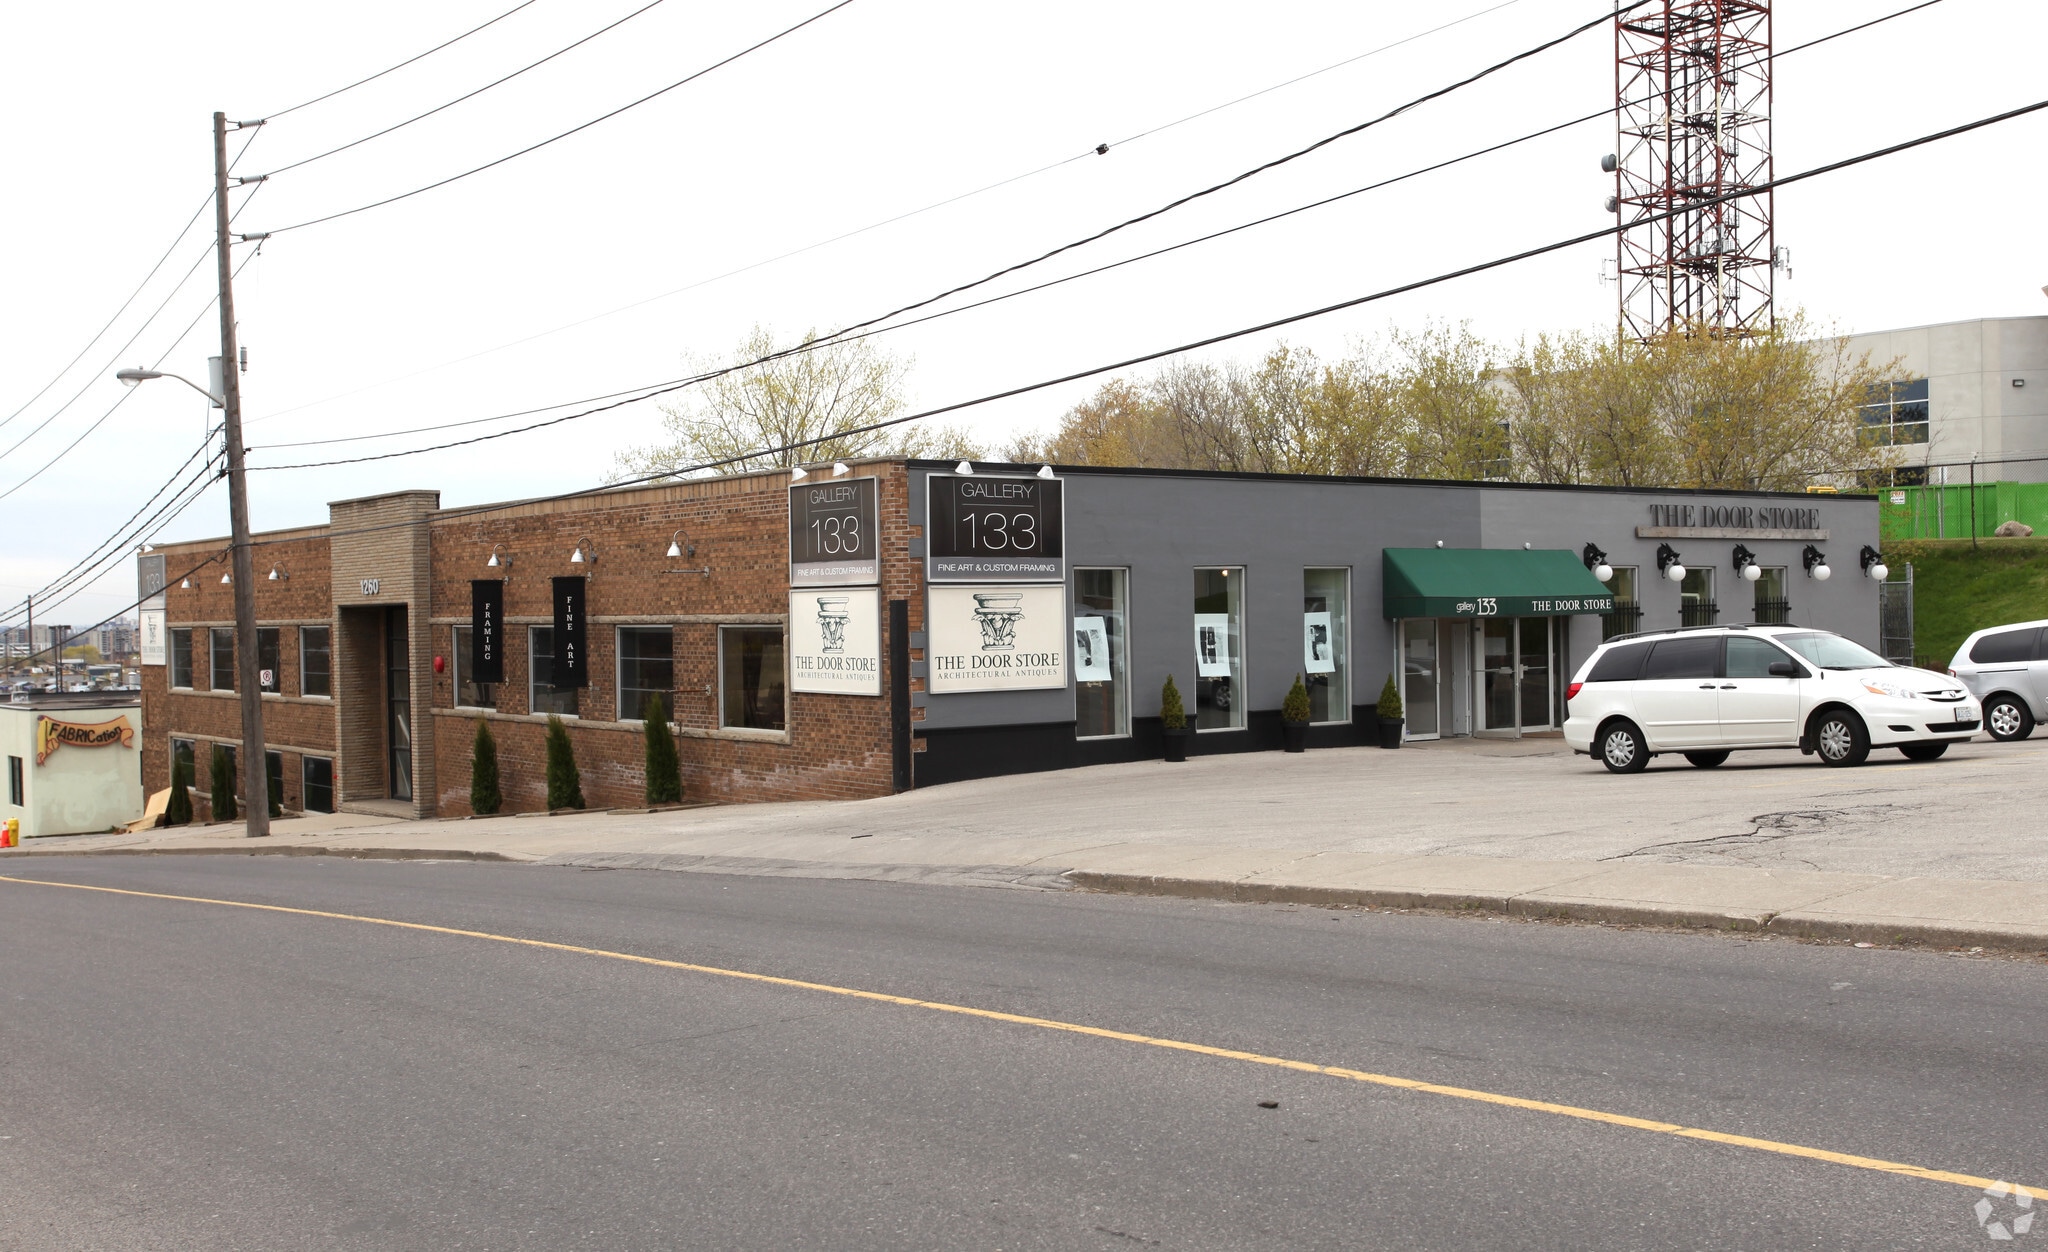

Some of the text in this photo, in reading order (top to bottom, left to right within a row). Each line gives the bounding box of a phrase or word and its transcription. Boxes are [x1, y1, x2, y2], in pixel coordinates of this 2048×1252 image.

[810, 487, 857, 504] GALLERY
[961, 482, 1034, 499] GALLERY
[1650, 504, 1820, 529] THE DOOR STORE
[811, 515, 860, 554] 133
[962, 513, 1036, 550] 133
[797, 566, 874, 577] FINE ART & CUSTOM FRAMING
[938, 563, 1056, 572] FINE ART & CUSTOM FRAMING
[360, 579, 379, 595] 1260
[1456, 598, 1498, 616] gallery 133
[1532, 599, 1612, 612] THE DOOR STORE
[483, 603, 492, 660] FRAMING
[567, 642, 575, 668] ART
[795, 655, 877, 672] THE DOOR STORE
[934, 653, 1060, 670] THE DOOR STORE
[797, 671, 875, 682] ARCHITECTURAL ANTIQUES
[937, 668, 1058, 680] ARCHITECTURAL ANTIQUES
